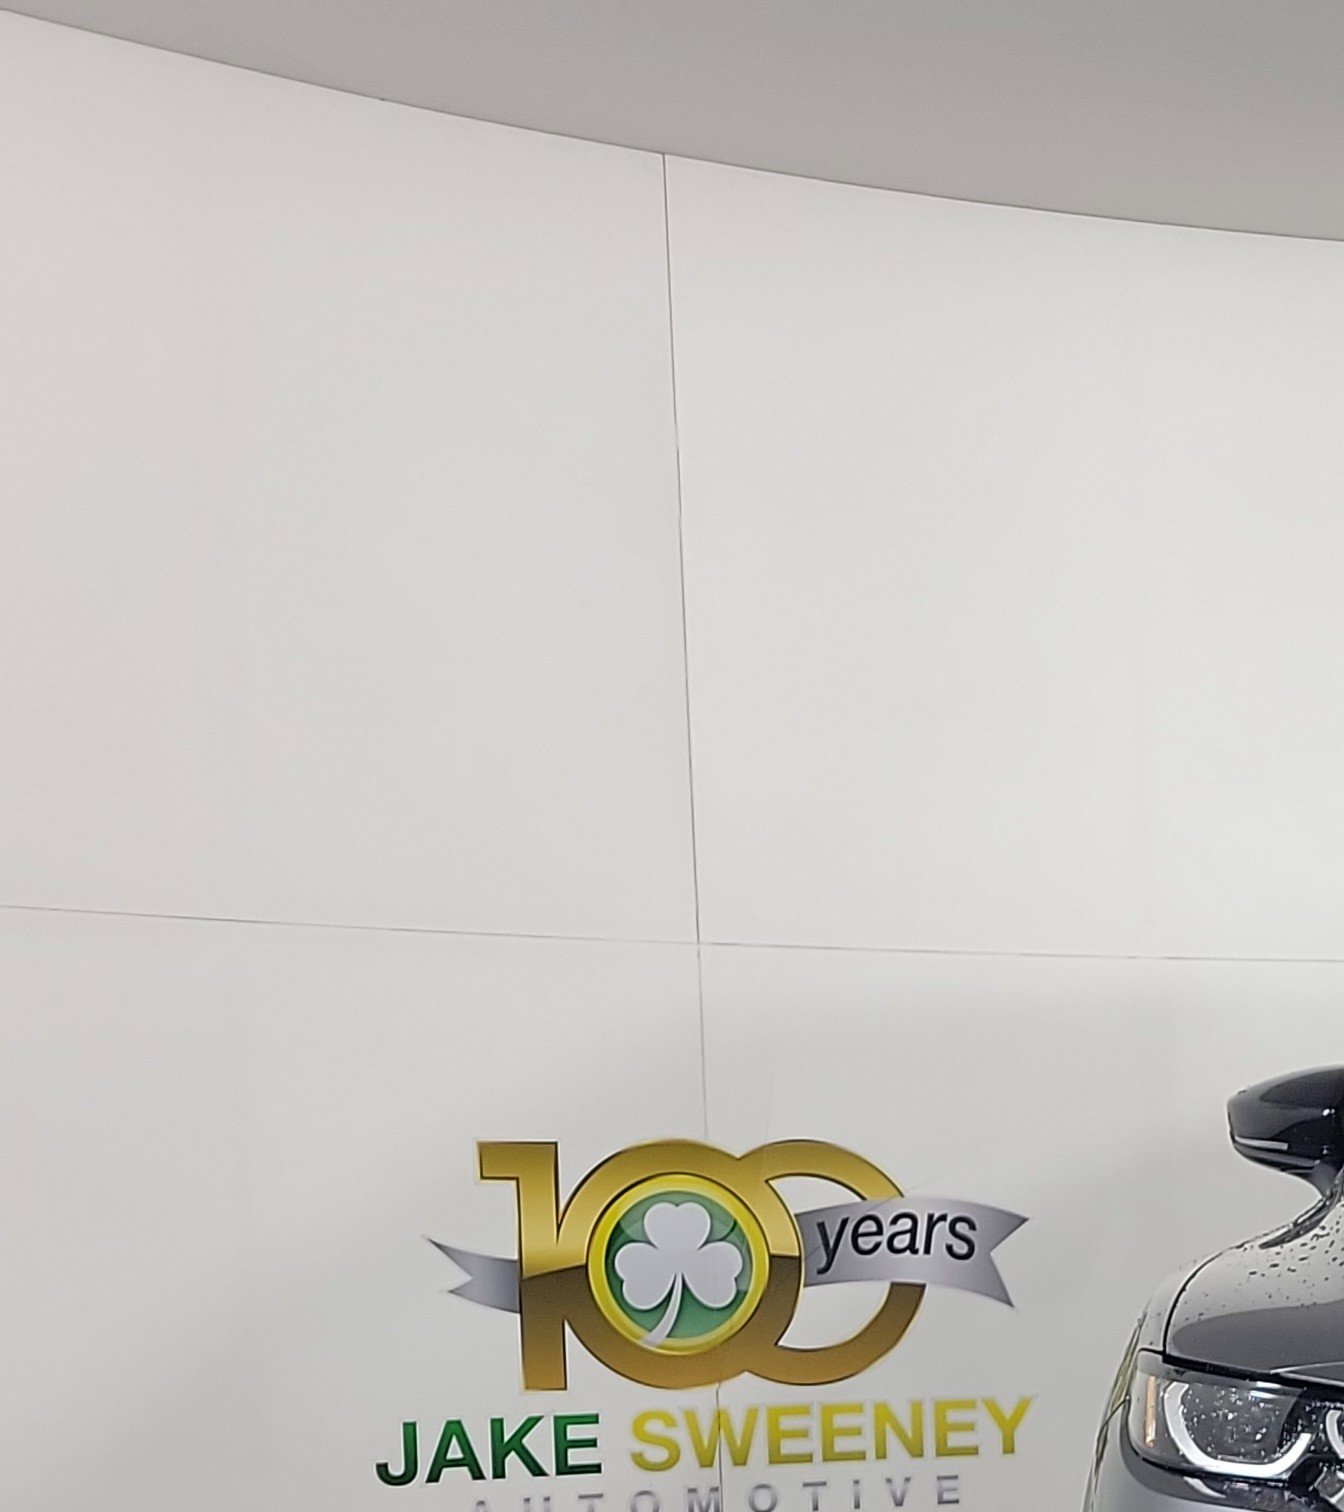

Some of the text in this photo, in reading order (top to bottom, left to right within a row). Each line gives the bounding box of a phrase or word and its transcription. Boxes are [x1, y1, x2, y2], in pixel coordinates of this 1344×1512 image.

[815, 1212, 978, 1274] years
[375, 1397, 1034, 1485] JAKE SWEENEY
